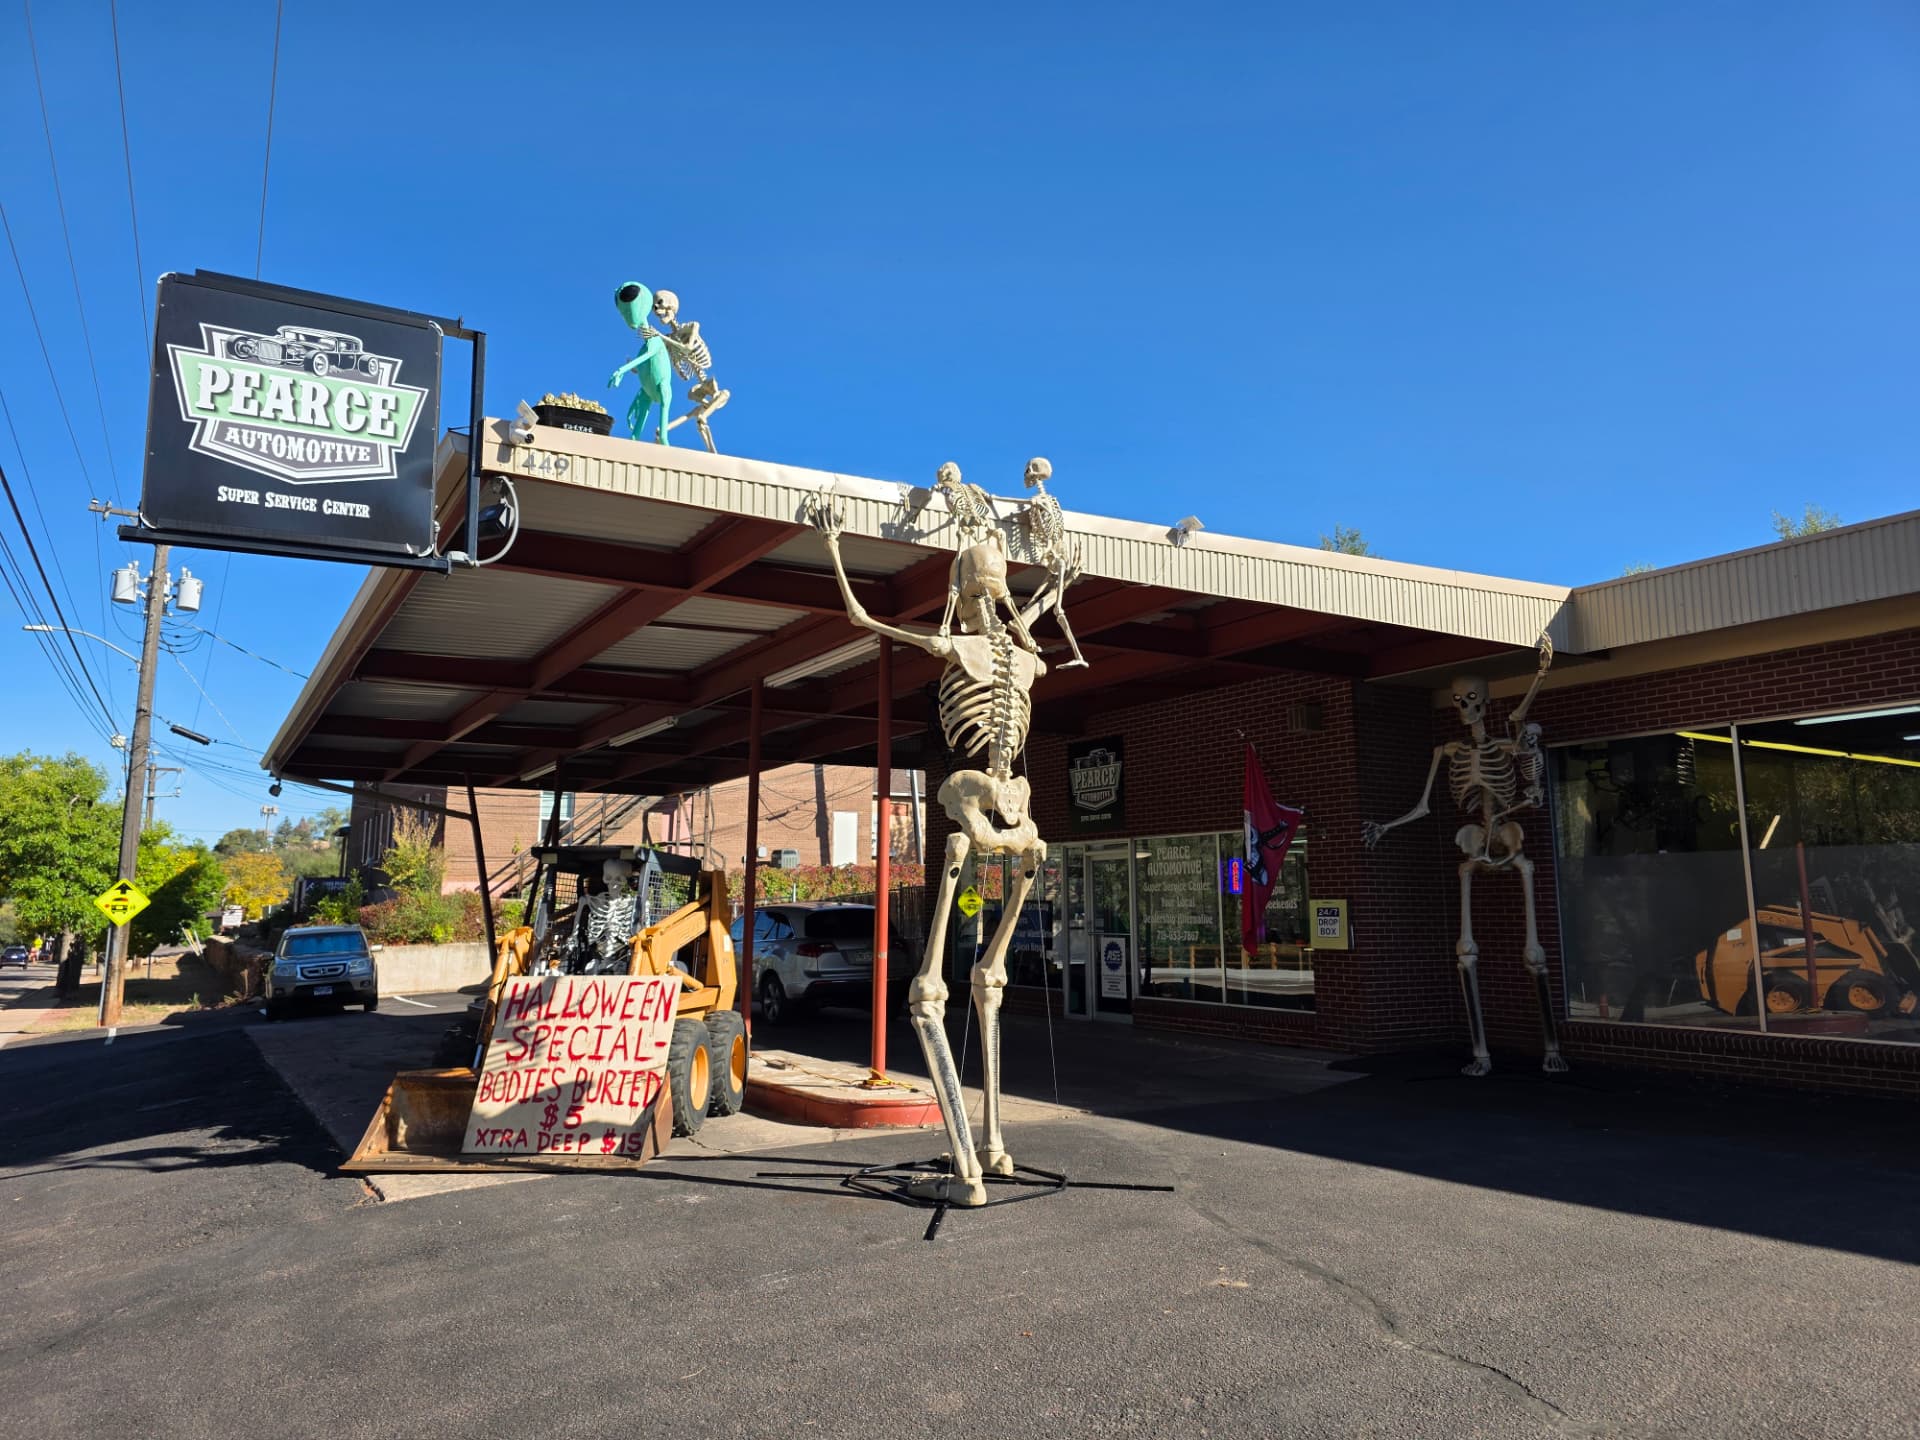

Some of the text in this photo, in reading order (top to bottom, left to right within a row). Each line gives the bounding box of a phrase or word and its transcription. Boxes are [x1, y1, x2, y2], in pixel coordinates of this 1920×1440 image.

[195, 362, 400, 439] PEARCE
[224, 426, 371, 464] AUTOMOTIVE
[521, 451, 569, 476] 449
[1074, 767, 1116, 789] PEARCE
[1156, 845, 1191, 861] PEARCE
[1147, 860, 1202, 876] AUTOMOTIVE
[1265, 898, 1299, 911] eekends
[1318, 908, 1338, 916] 24/7
[1318, 918, 1338, 927] DROP
[1320, 927, 1337, 936] BOX
[504, 979, 676, 1022] HALLOWEEN
[479, 1067, 663, 1108] BODIES BURIED
[475, 1128, 642, 1154] XTRA DEEP $15
